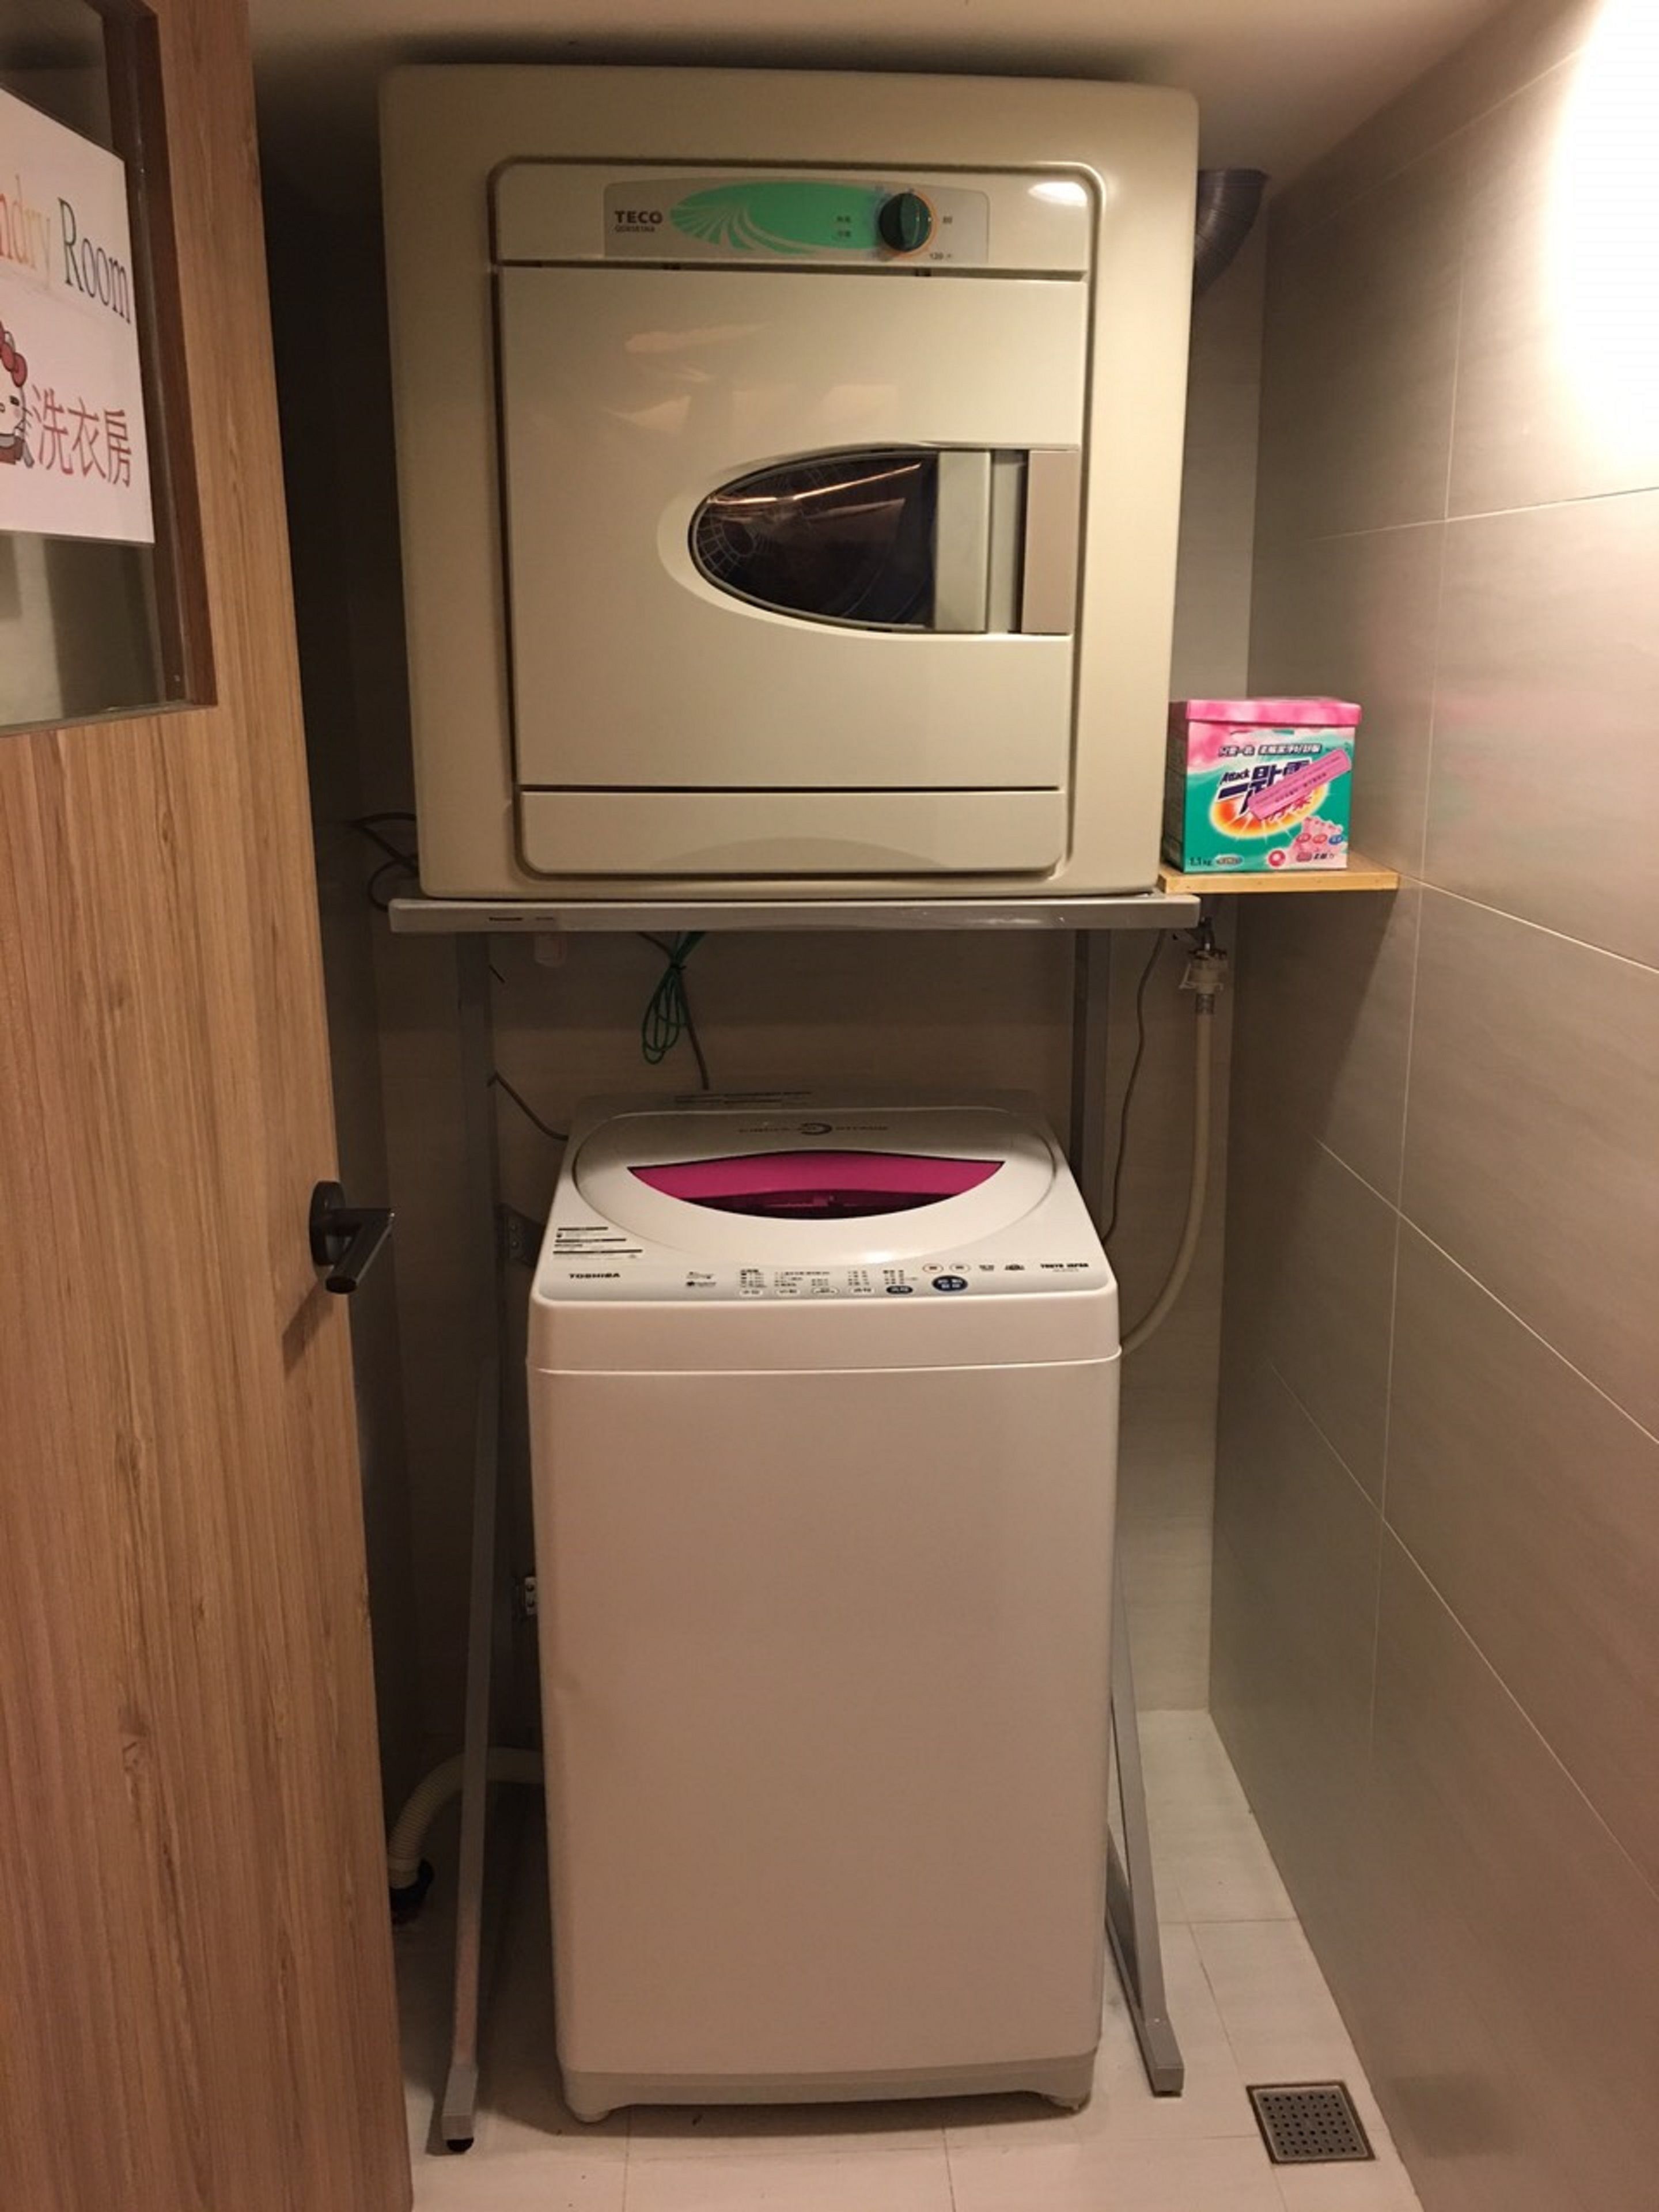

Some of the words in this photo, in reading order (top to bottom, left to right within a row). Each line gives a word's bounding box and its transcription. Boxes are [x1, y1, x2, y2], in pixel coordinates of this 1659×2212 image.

[57, 196, 131, 324] Room
[615, 211, 663, 225] TECO
[32, 384, 132, 488] 洗衣房
